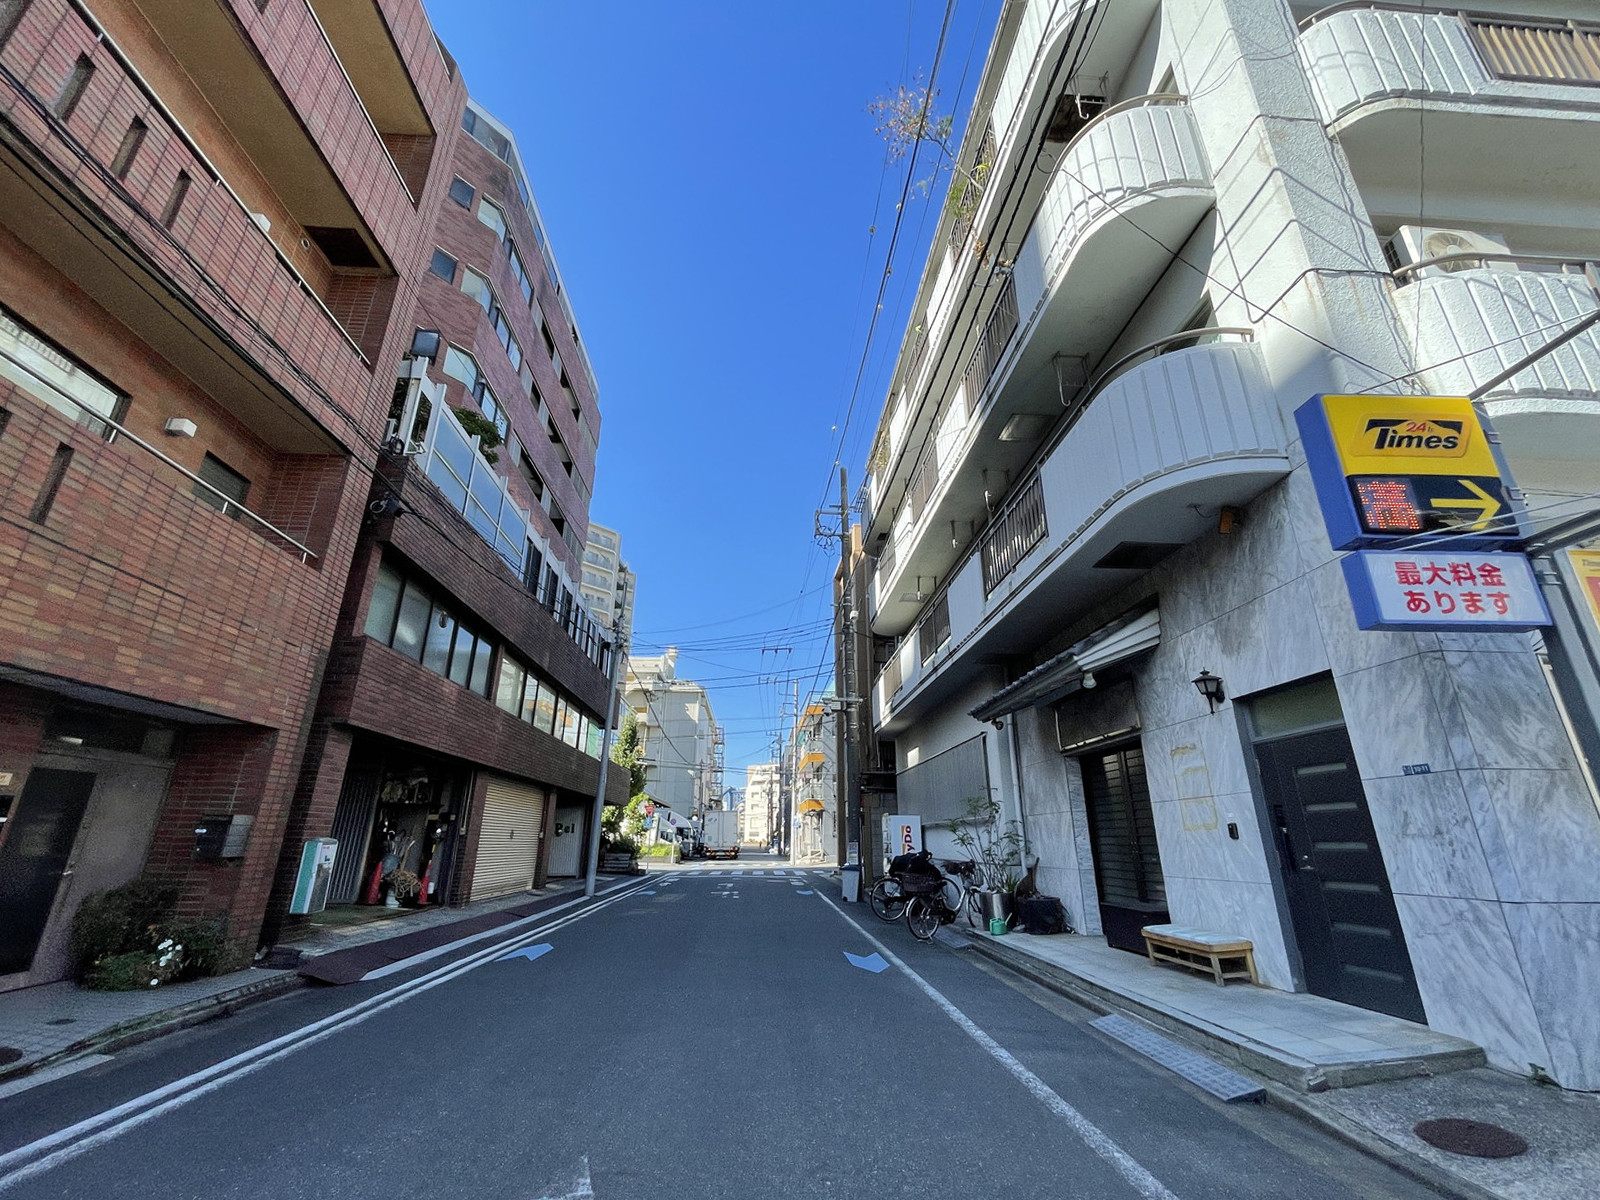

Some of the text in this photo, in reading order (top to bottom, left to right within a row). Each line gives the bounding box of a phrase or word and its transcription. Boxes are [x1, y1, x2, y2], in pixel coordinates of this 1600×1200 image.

[1374, 427, 1459, 449] Times
[1357, 481, 1420, 530] 満
[1395, 561, 1506, 586] 最大料金
[1403, 590, 1510, 614] あります
[904, 825, 915, 852] yDo
